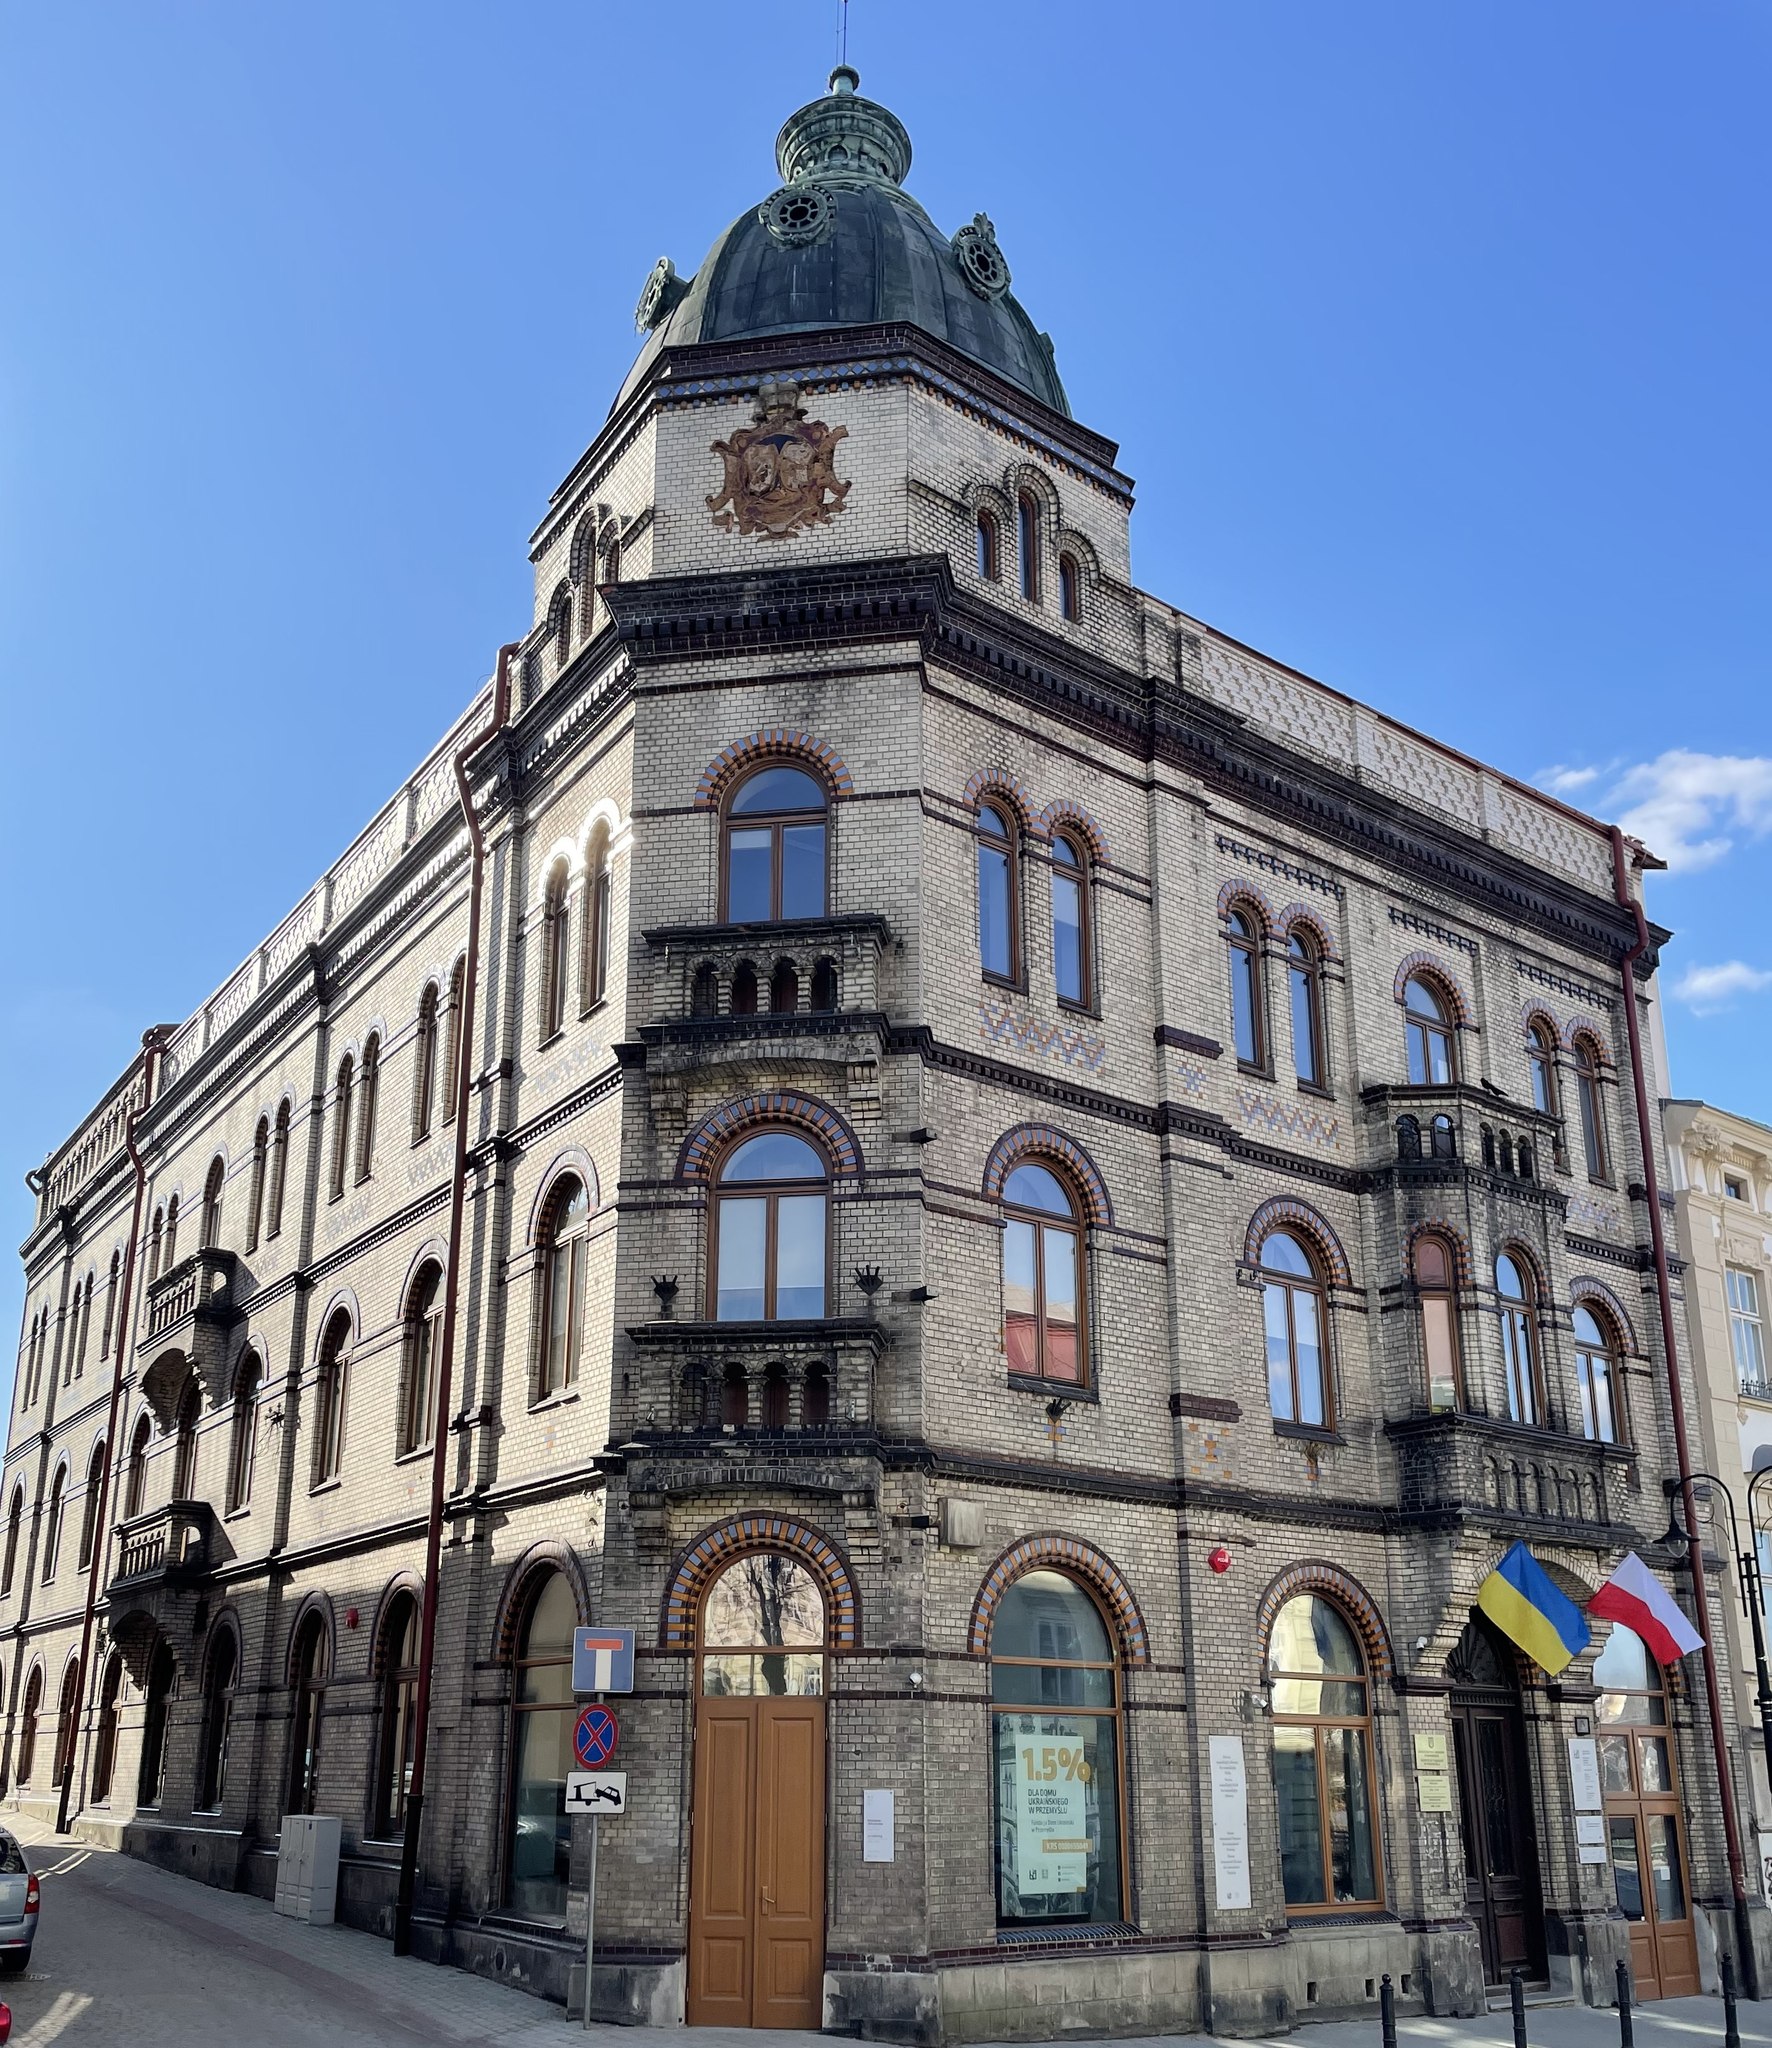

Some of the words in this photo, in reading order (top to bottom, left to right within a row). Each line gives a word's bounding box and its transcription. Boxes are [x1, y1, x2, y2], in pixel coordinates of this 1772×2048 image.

[1022, 1747, 1091, 1782] 1.5%
[1028, 1788, 1039, 1796] DLA
[1040, 1788, 1056, 1796] DOMU
[1029, 1806, 1035, 1814] W
[1036, 1806, 1067, 1814] PRZEMYŚLU
